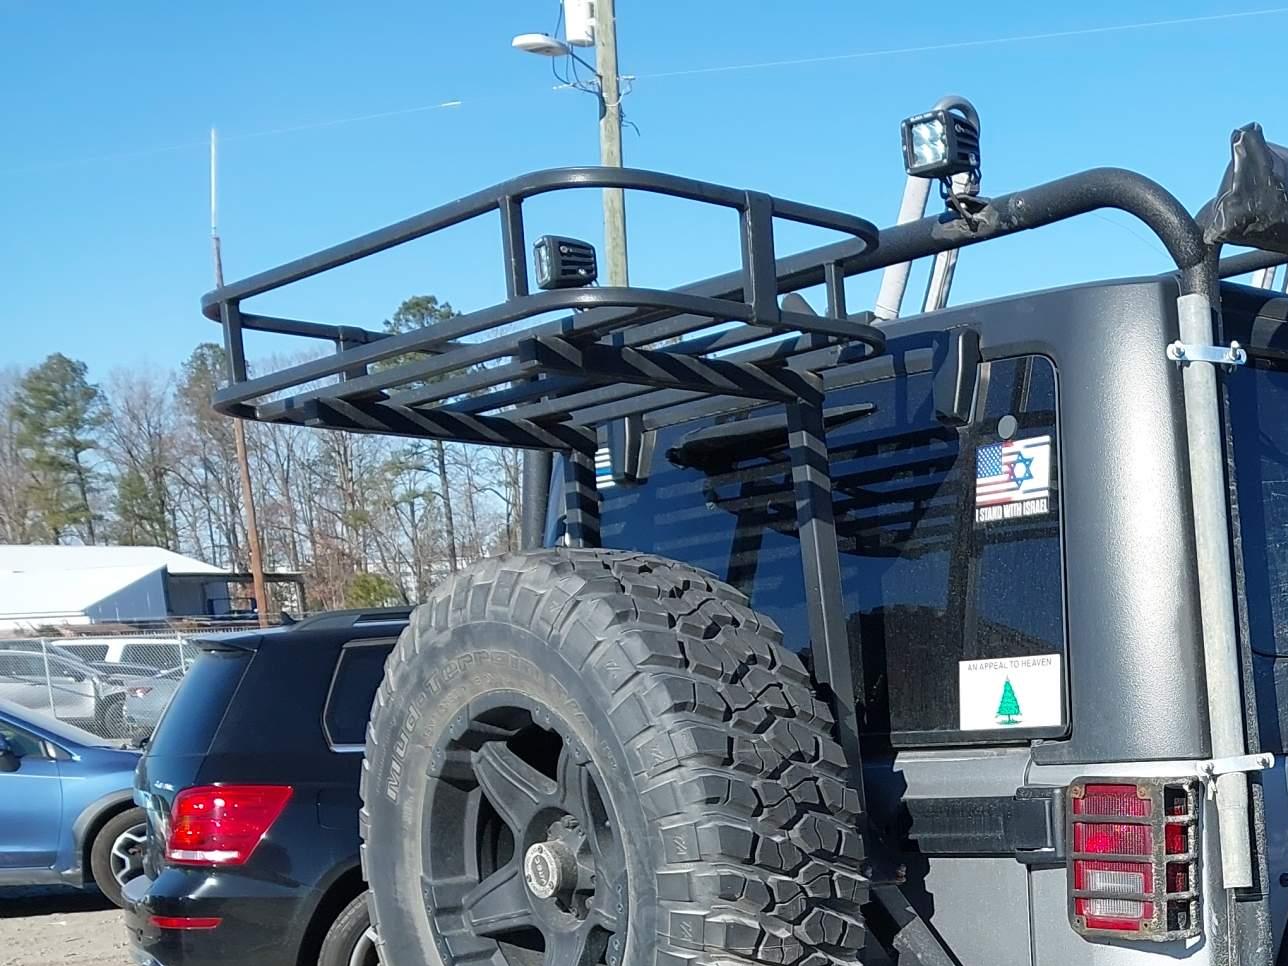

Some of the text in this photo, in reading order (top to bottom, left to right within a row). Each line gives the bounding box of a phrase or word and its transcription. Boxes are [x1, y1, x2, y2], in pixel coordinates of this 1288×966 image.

[980, 505, 1003, 522] STAND
[1003, 502, 1022, 518] WITH
[1023, 498, 1047, 515] ISRAEL
[967, 657, 1052, 671] AN APPEAL TO HEAVEN
